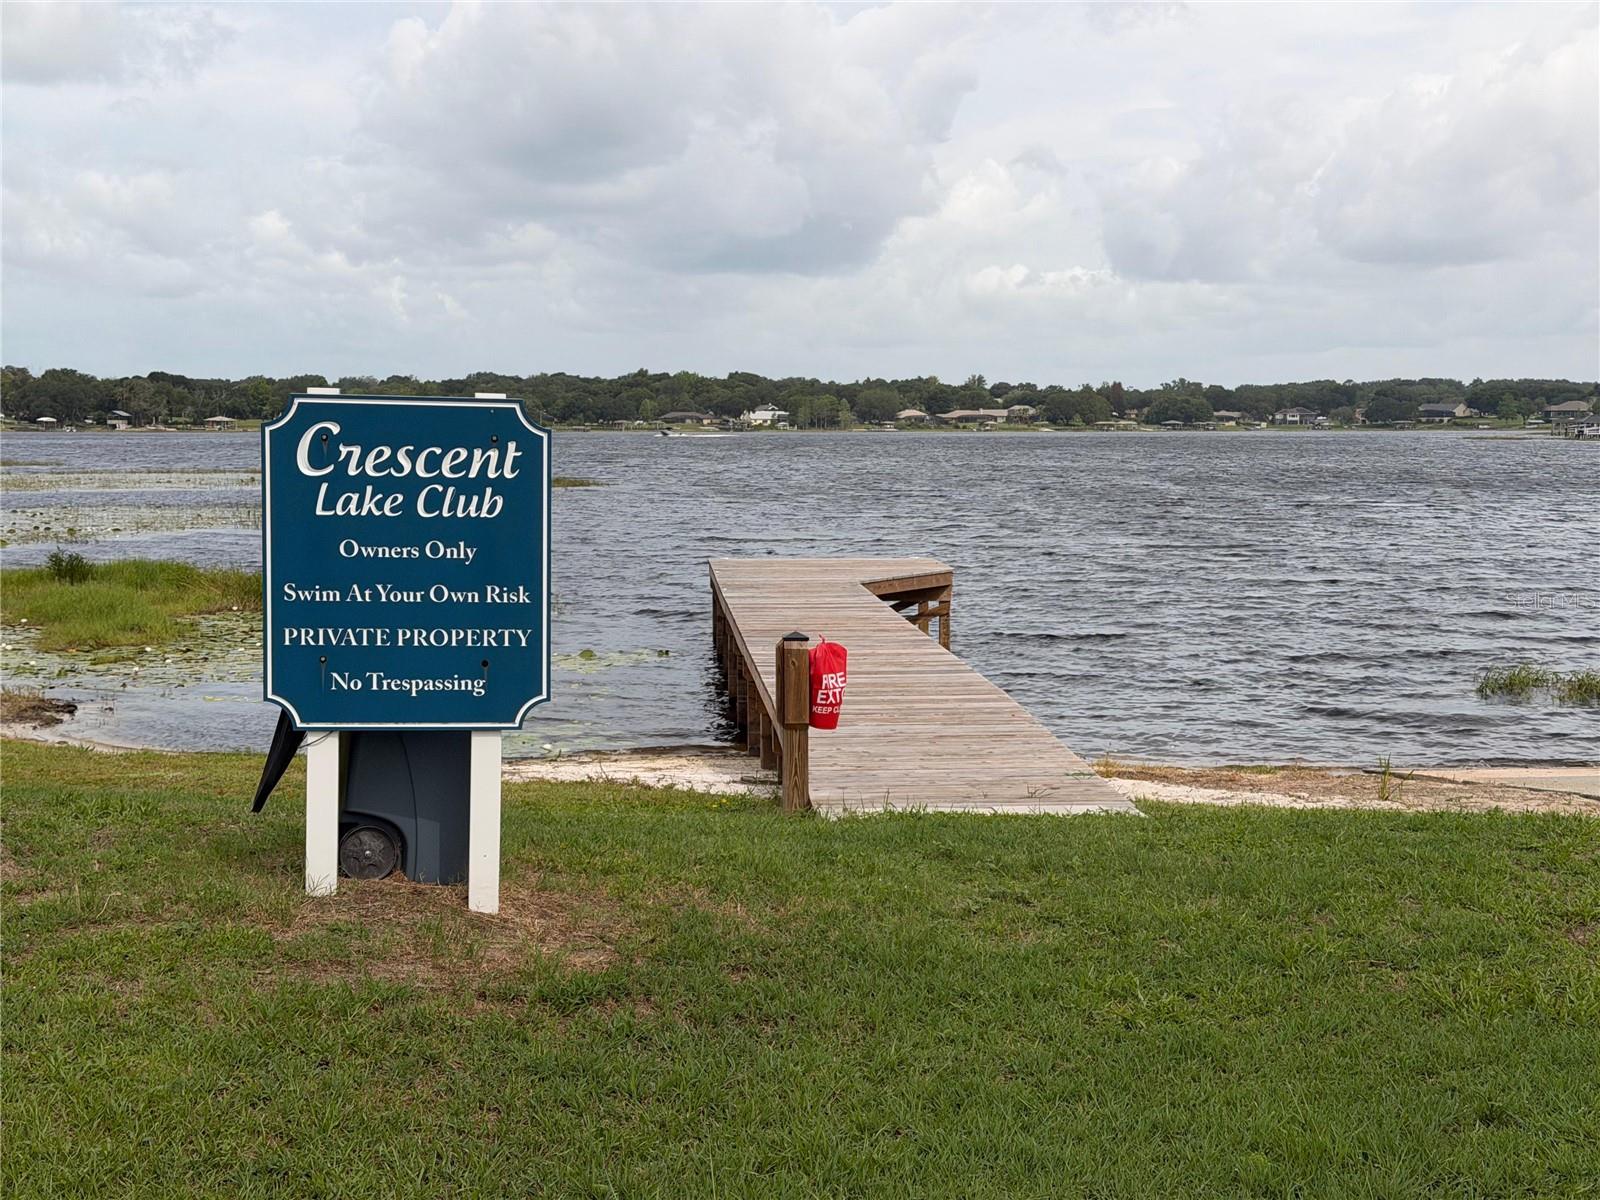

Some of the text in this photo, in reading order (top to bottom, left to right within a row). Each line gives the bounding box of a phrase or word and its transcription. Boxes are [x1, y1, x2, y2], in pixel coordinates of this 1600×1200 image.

[297, 421, 522, 479] Crescent
[315, 482, 504, 518] Lake Club
[339, 539, 477, 565] Owners Only
[283, 583, 531, 604] Swim At Your Own Risk
[283, 627, 532, 648] PRIVATE PROPERTY
[331, 671, 486, 697] No Trespassing
[812, 705, 832, 714] KEEP
